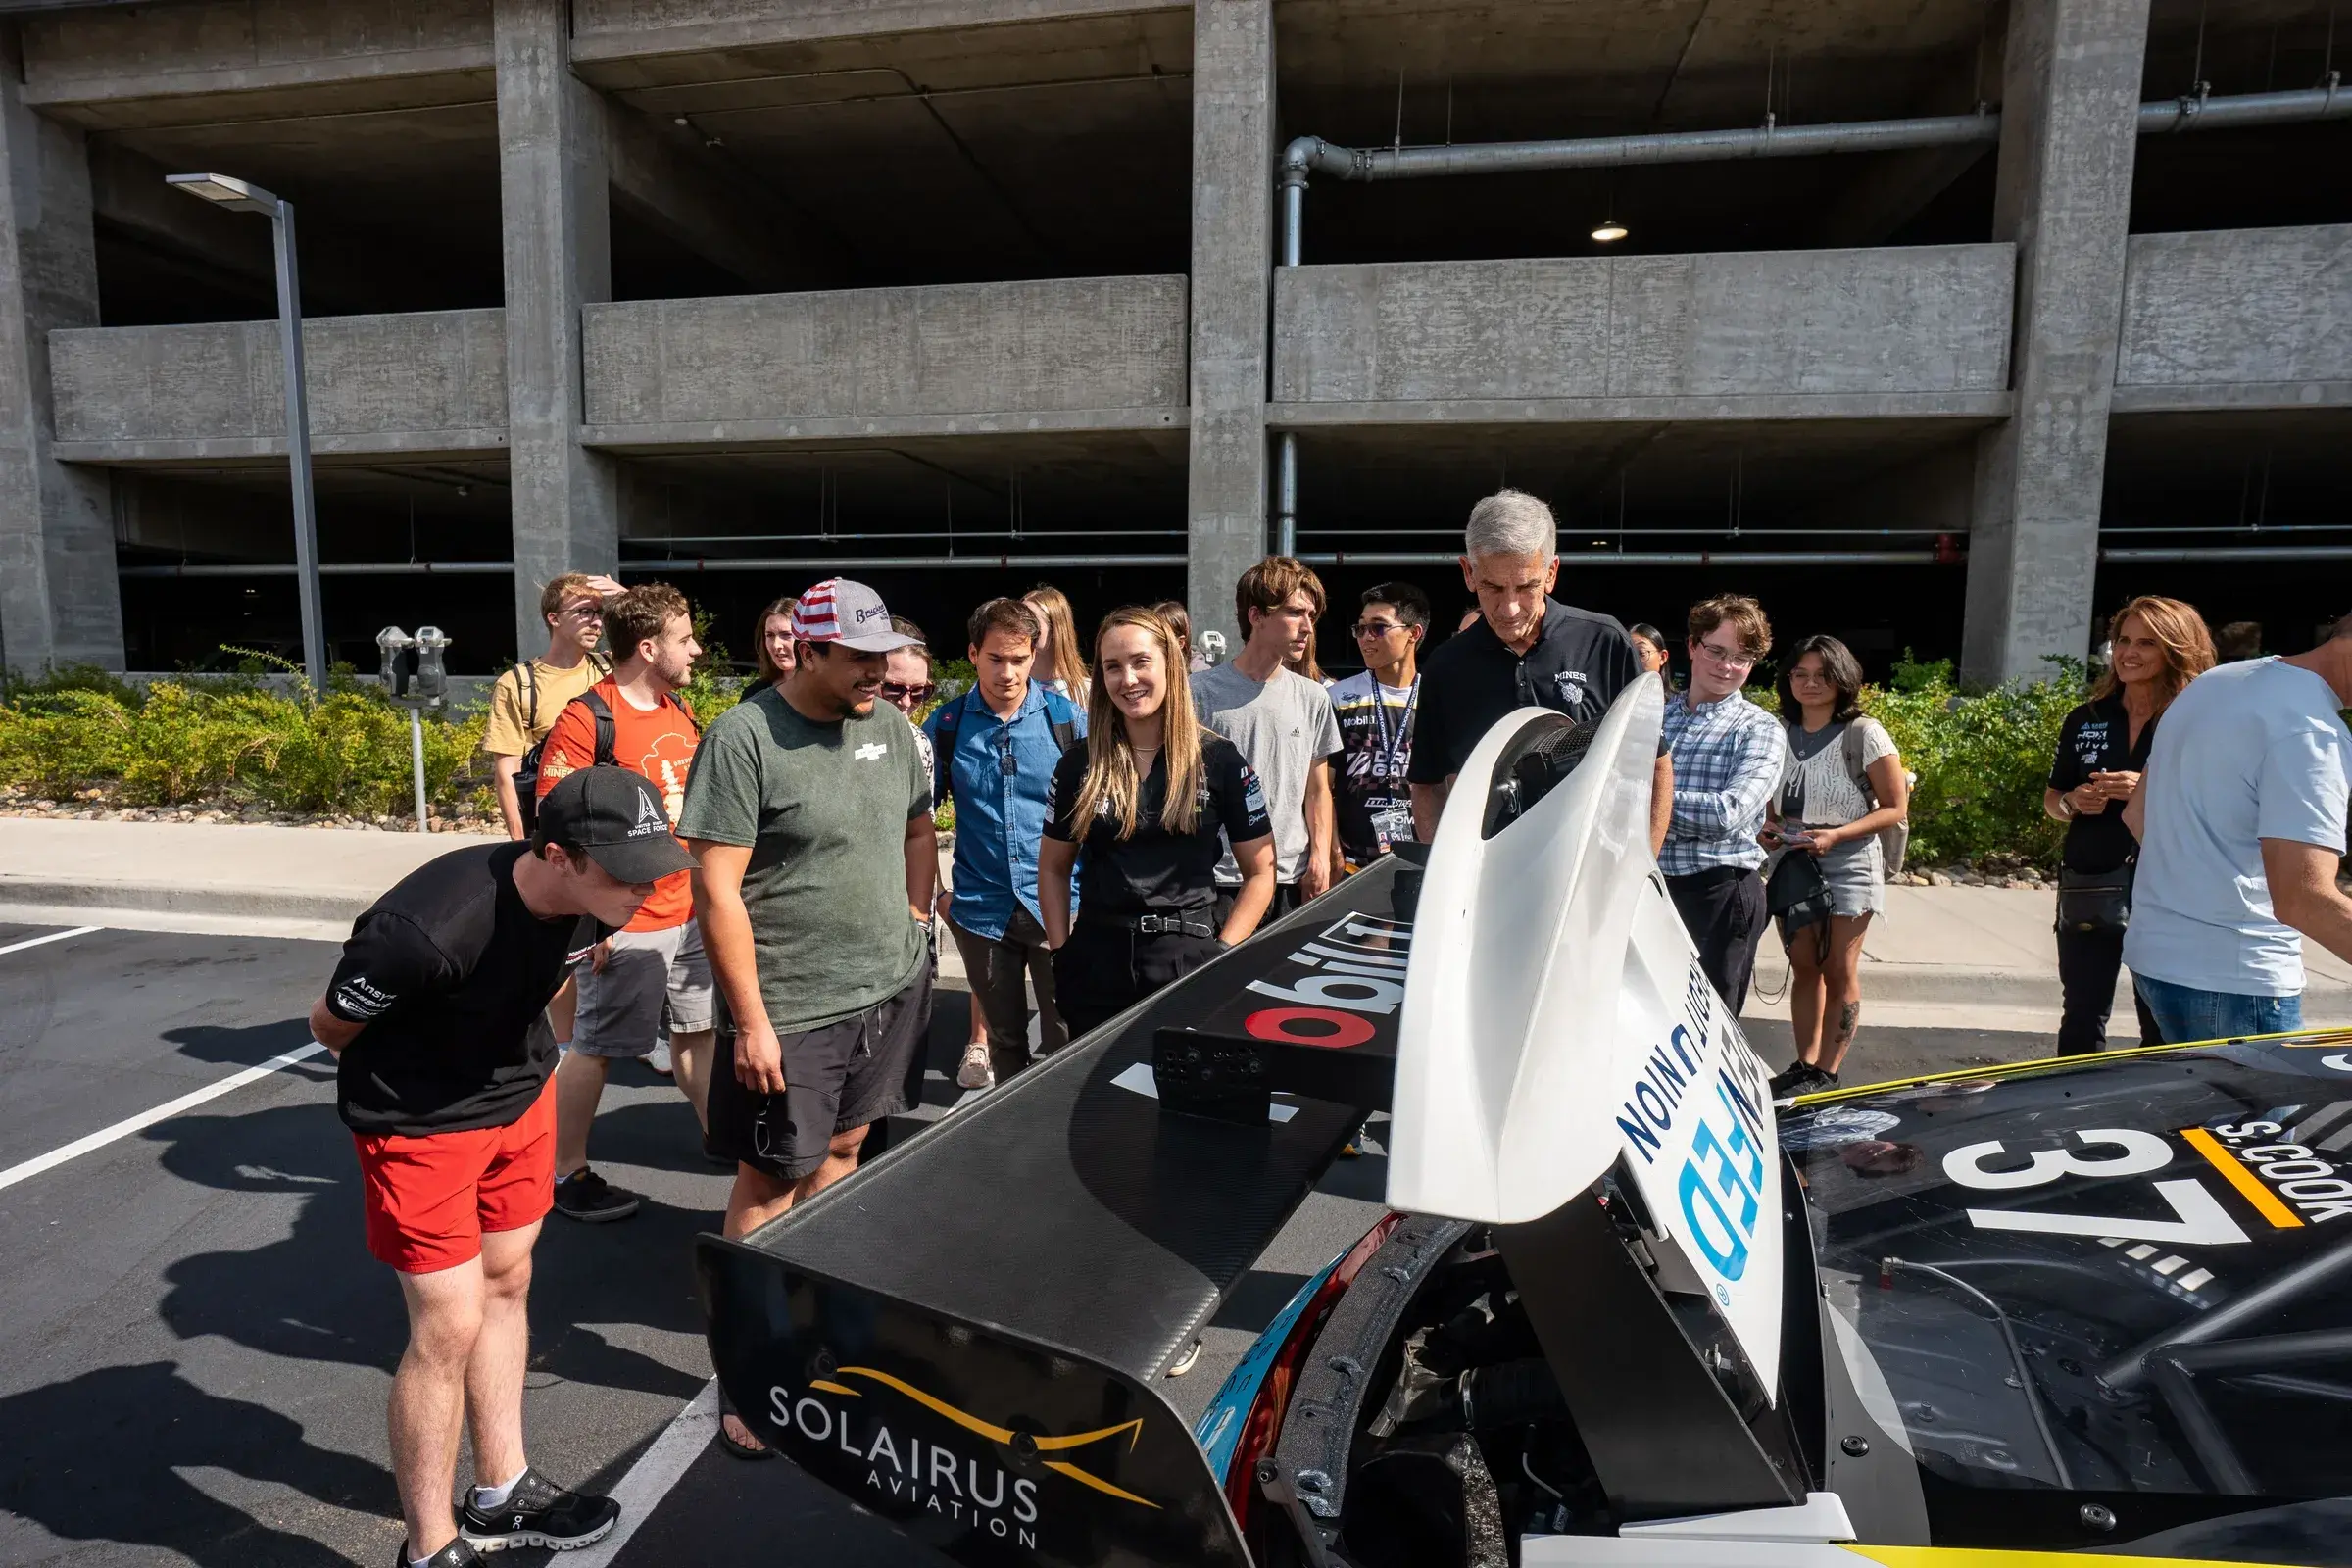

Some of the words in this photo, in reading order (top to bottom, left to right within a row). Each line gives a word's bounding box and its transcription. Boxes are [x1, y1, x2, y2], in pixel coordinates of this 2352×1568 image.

[1554, 671, 1587, 683] MINES
[1344, 715, 1368, 728] Mobil
[627, 827, 651, 837] SPACE
[653, 824, 668, 833] FORCE
[353, 977, 398, 1001] Ansys
[1616, 1024, 1703, 1165] UNION
[1942, 1128, 2252, 1246] 37
[769, 1386, 1038, 1523] SOLAIRUS
[867, 1470, 1036, 1549] AVIATION
